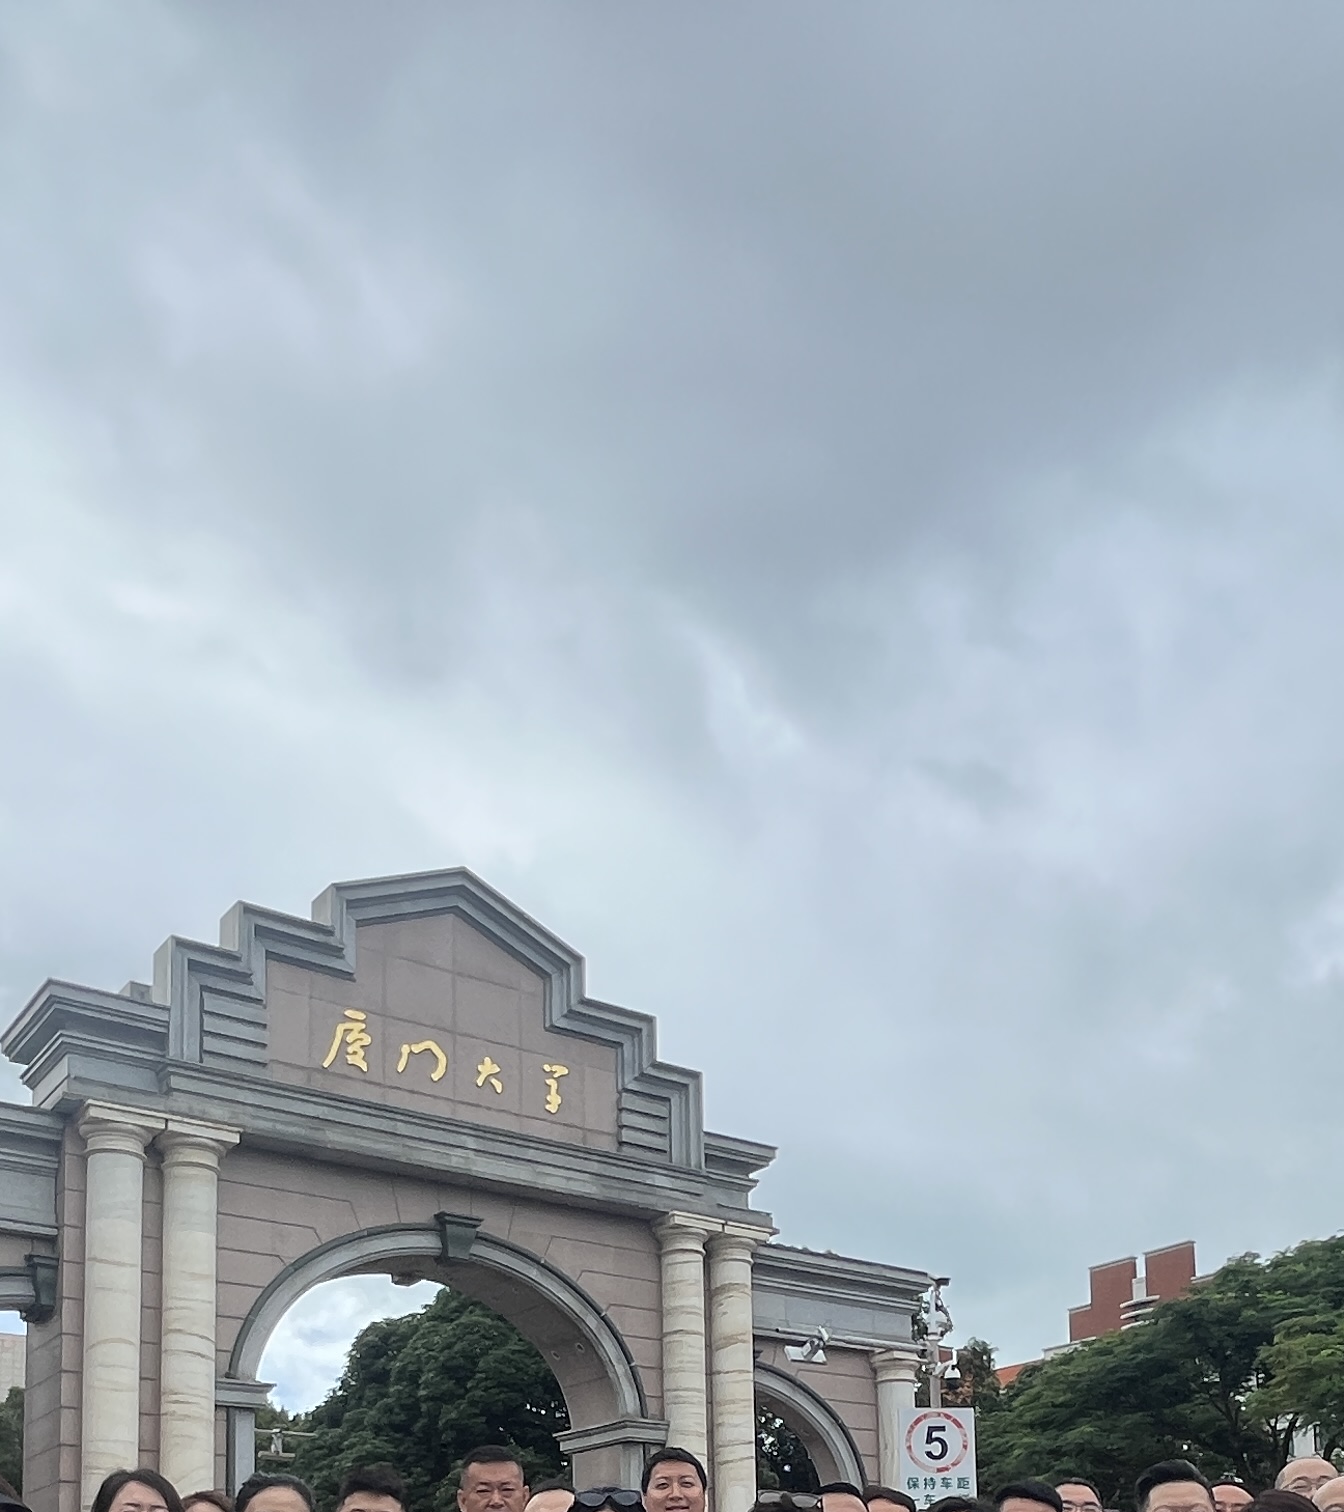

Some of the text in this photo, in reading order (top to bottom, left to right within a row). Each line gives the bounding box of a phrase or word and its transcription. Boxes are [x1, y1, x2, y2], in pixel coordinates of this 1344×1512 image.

[925, 1426, 949, 1460] 5
[907, 1477, 970, 1490] 保持车距
